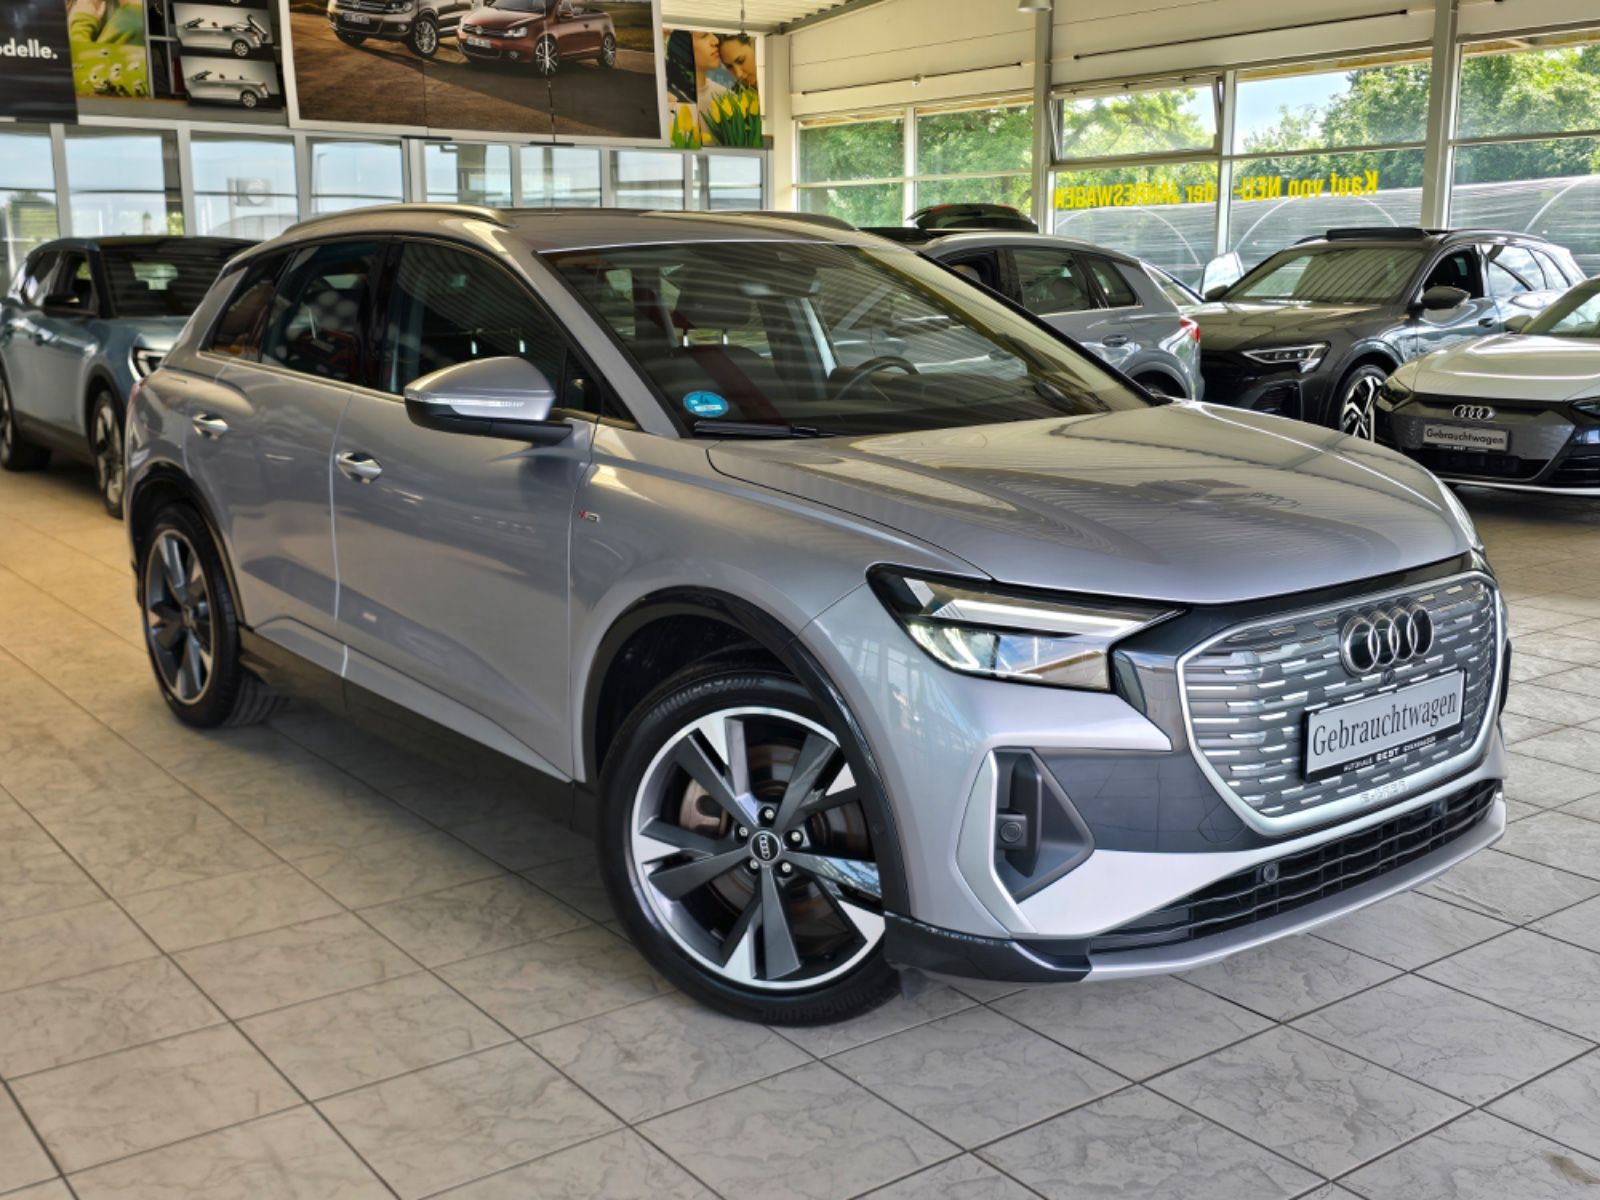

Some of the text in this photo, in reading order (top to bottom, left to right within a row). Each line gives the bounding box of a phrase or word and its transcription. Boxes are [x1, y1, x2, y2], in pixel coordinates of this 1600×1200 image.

[0, 37, 58, 59] delle.
[1426, 428, 1504, 445] Gebrauchtwagen
[1313, 691, 1457, 756] Gebrauchtwagen
